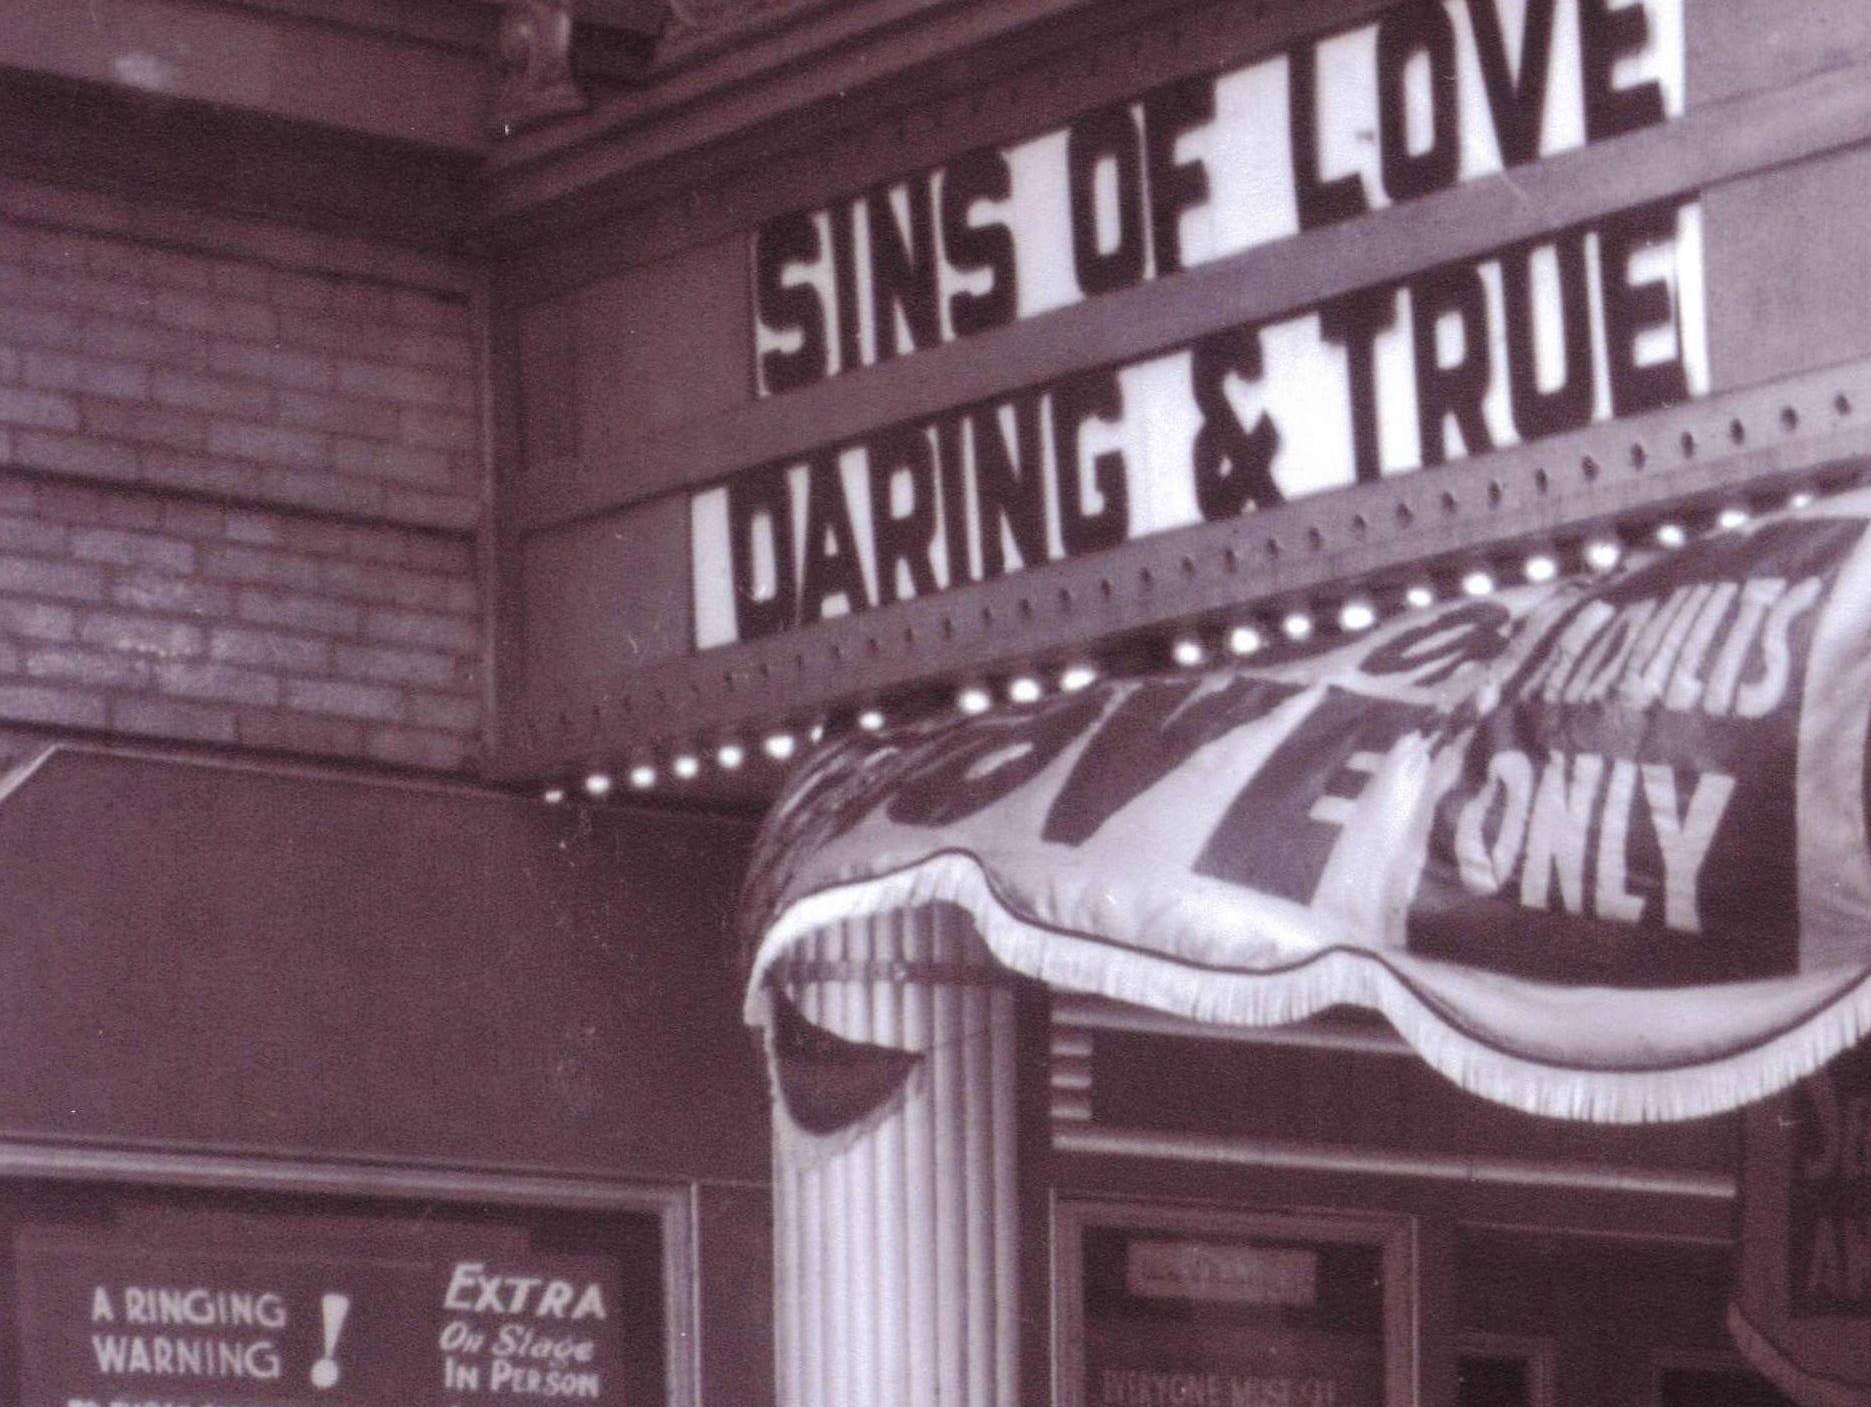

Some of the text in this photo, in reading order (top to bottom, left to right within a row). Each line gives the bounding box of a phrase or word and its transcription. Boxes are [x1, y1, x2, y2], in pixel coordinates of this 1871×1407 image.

[756, 148, 1017, 396] SINS
[1070, 81, 1218, 292] OF
[735, 207, 1679, 638] DARING & TRUE
[1455, 748, 1737, 935] ONLY
[91, 1286, 287, 1328] A RINGING
[443, 1260, 607, 1320] EXTRA
[91, 1334, 282, 1379] WARNING
[439, 1320, 596, 1366] On Stage
